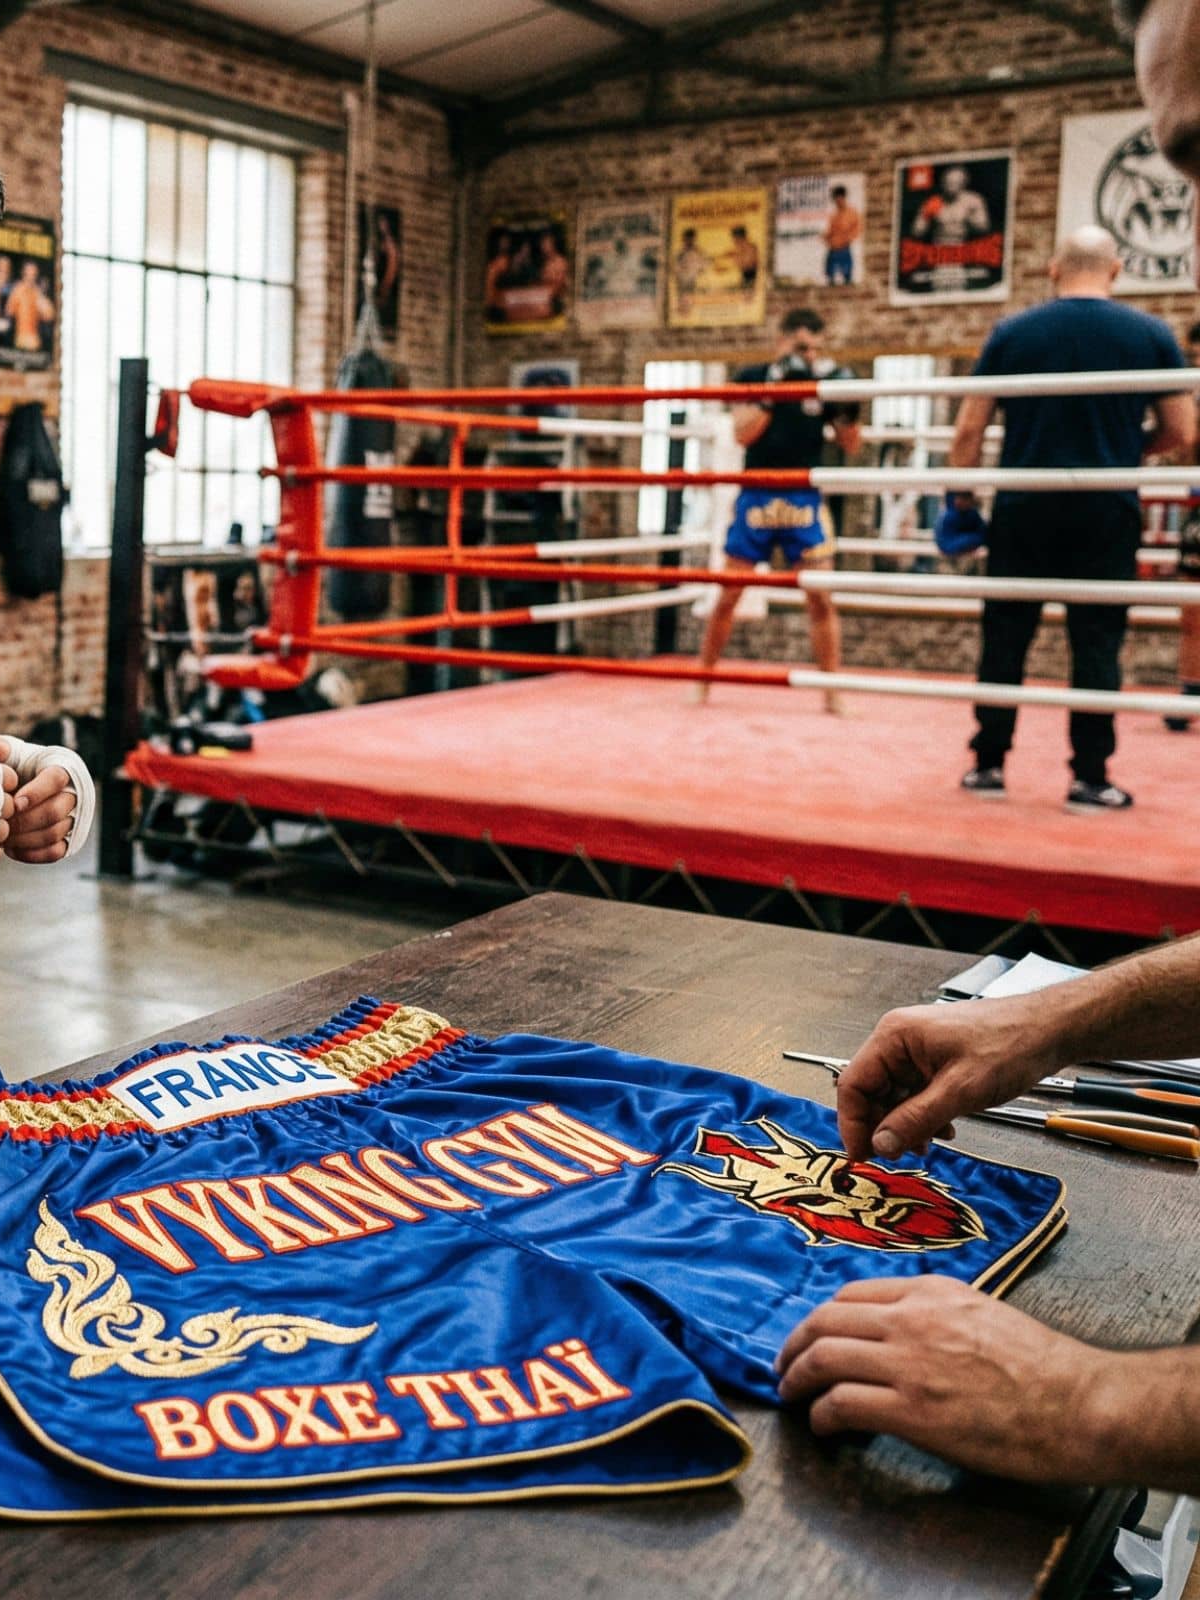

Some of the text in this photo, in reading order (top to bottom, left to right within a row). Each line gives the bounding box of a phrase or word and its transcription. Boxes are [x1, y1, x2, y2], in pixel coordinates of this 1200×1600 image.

[126, 1051, 337, 1120] FRANCE
[75, 1102, 663, 1275] VYKING GYM
[134, 1337, 633, 1460] BOXE THAÏ
